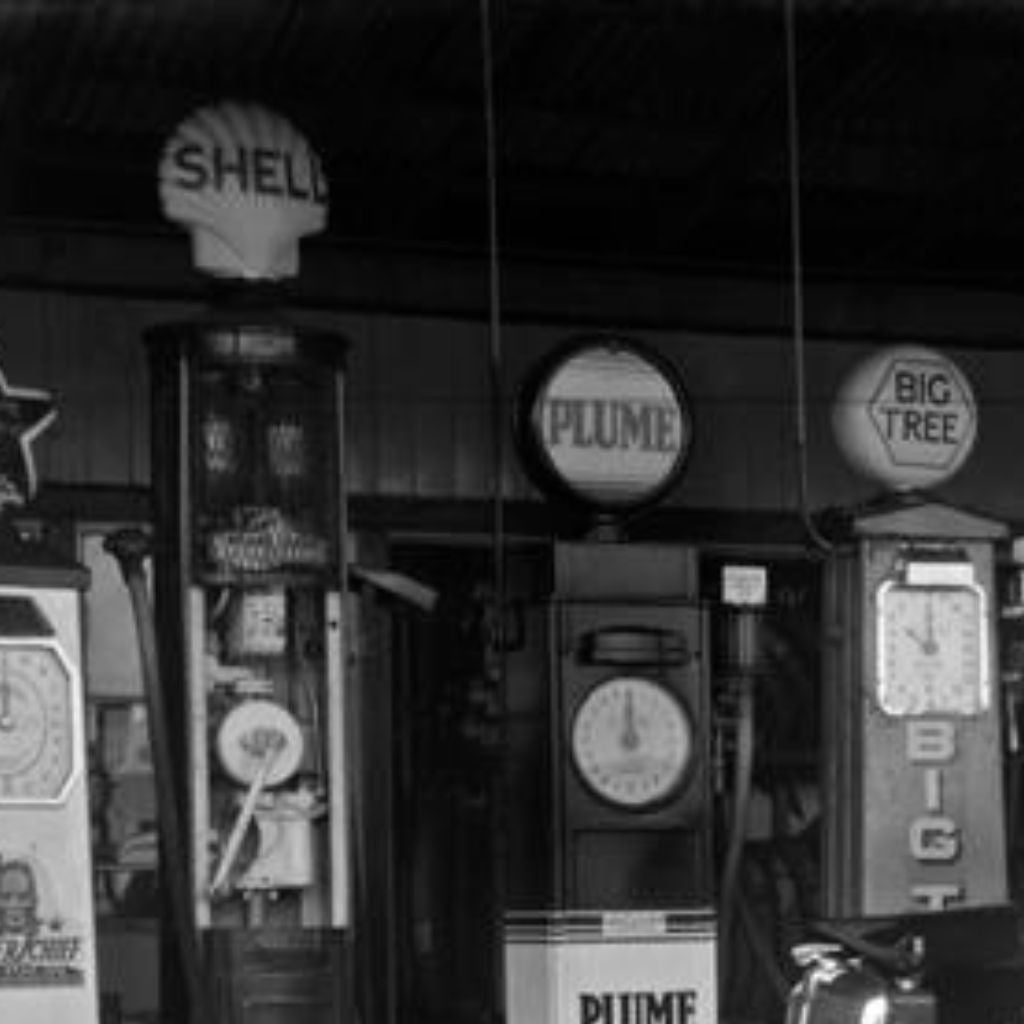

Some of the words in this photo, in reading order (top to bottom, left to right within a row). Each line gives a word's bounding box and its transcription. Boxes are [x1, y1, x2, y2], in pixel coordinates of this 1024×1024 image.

[173, 144, 328, 203] SHELL
[895, 370, 951, 405] BIG
[550, 399, 678, 451] PLUME
[880, 406, 959, 444] TREE
